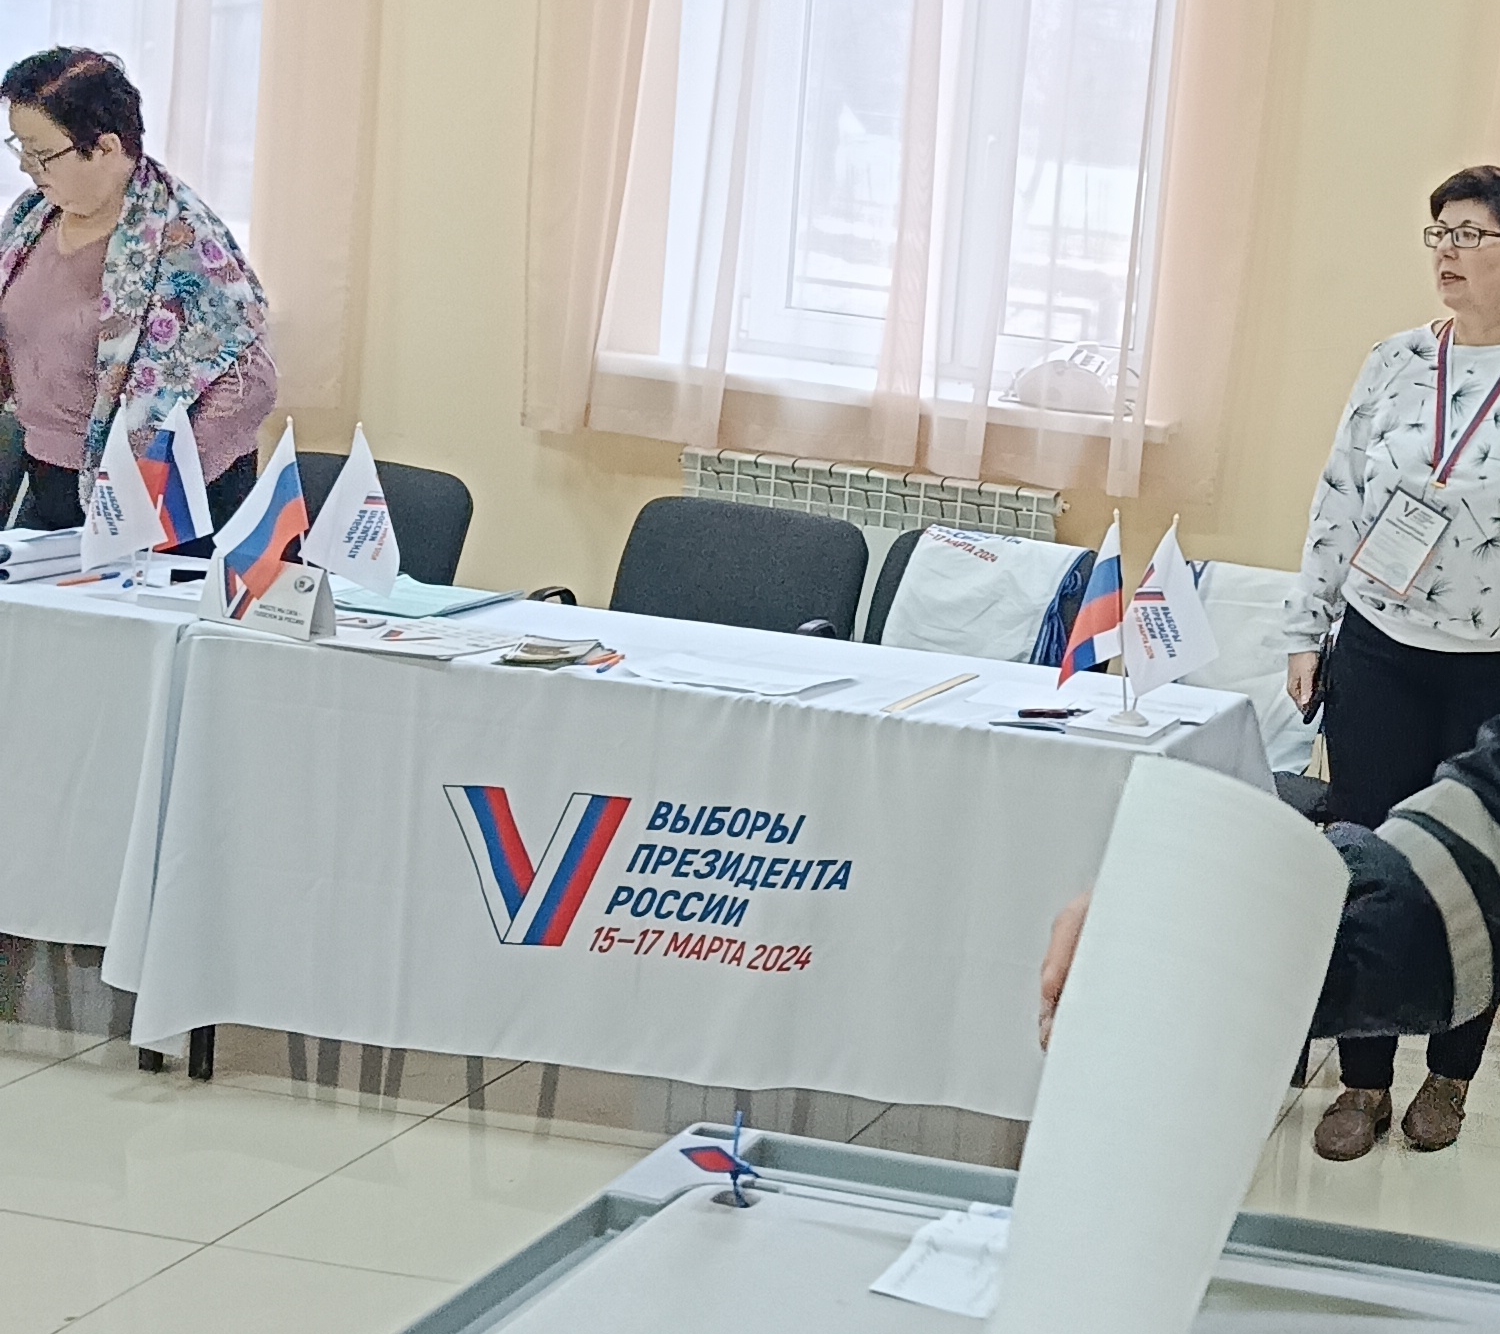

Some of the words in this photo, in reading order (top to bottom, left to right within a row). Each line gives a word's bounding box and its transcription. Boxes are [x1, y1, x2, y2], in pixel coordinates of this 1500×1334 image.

[1140, 606, 1158, 640] РОССИИ
[1149, 606, 1177, 659] ПРЕЗИДЕНТА
[1160, 606, 1182, 643] ВЫБОРЫ
[646, 800, 806, 845] ВЫБОРЫ
[626, 843, 853, 891] ПРЕЗИДЕНТА
[605, 885, 750, 928] РОССИИ
[662, 932, 747, 967] МАРТА
[746, 944, 813, 972] 2024
